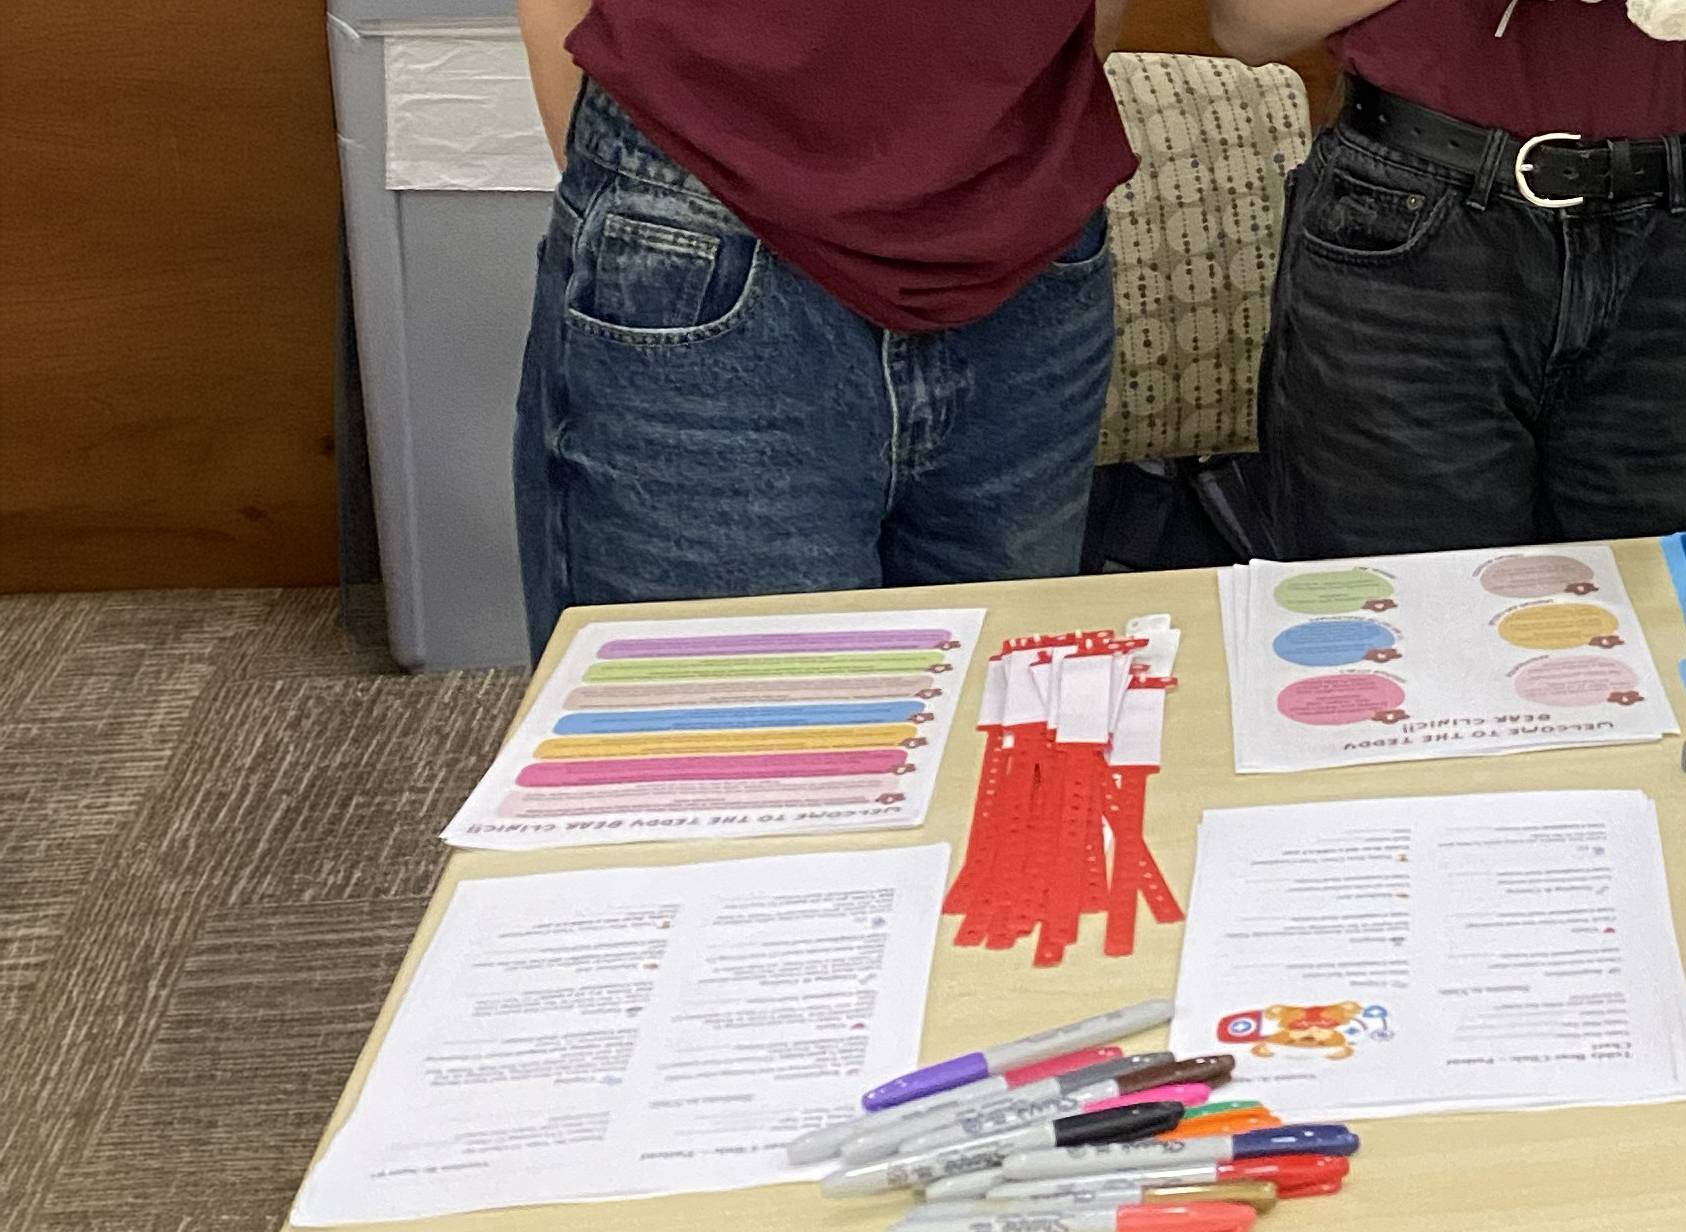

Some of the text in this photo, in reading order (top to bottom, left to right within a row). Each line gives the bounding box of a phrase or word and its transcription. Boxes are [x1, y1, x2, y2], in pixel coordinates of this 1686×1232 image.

[1493, 713, 1551, 723] BEAR
[1343, 721, 1614, 750] WELCOME TO THE TEDDY
[758, 813, 795, 823] TO
[799, 806, 902, 821] WELCOME
[630, 816, 701, 829] TEDDY
[711, 815, 748, 826] THE
[567, 821, 623, 832] BEAR
